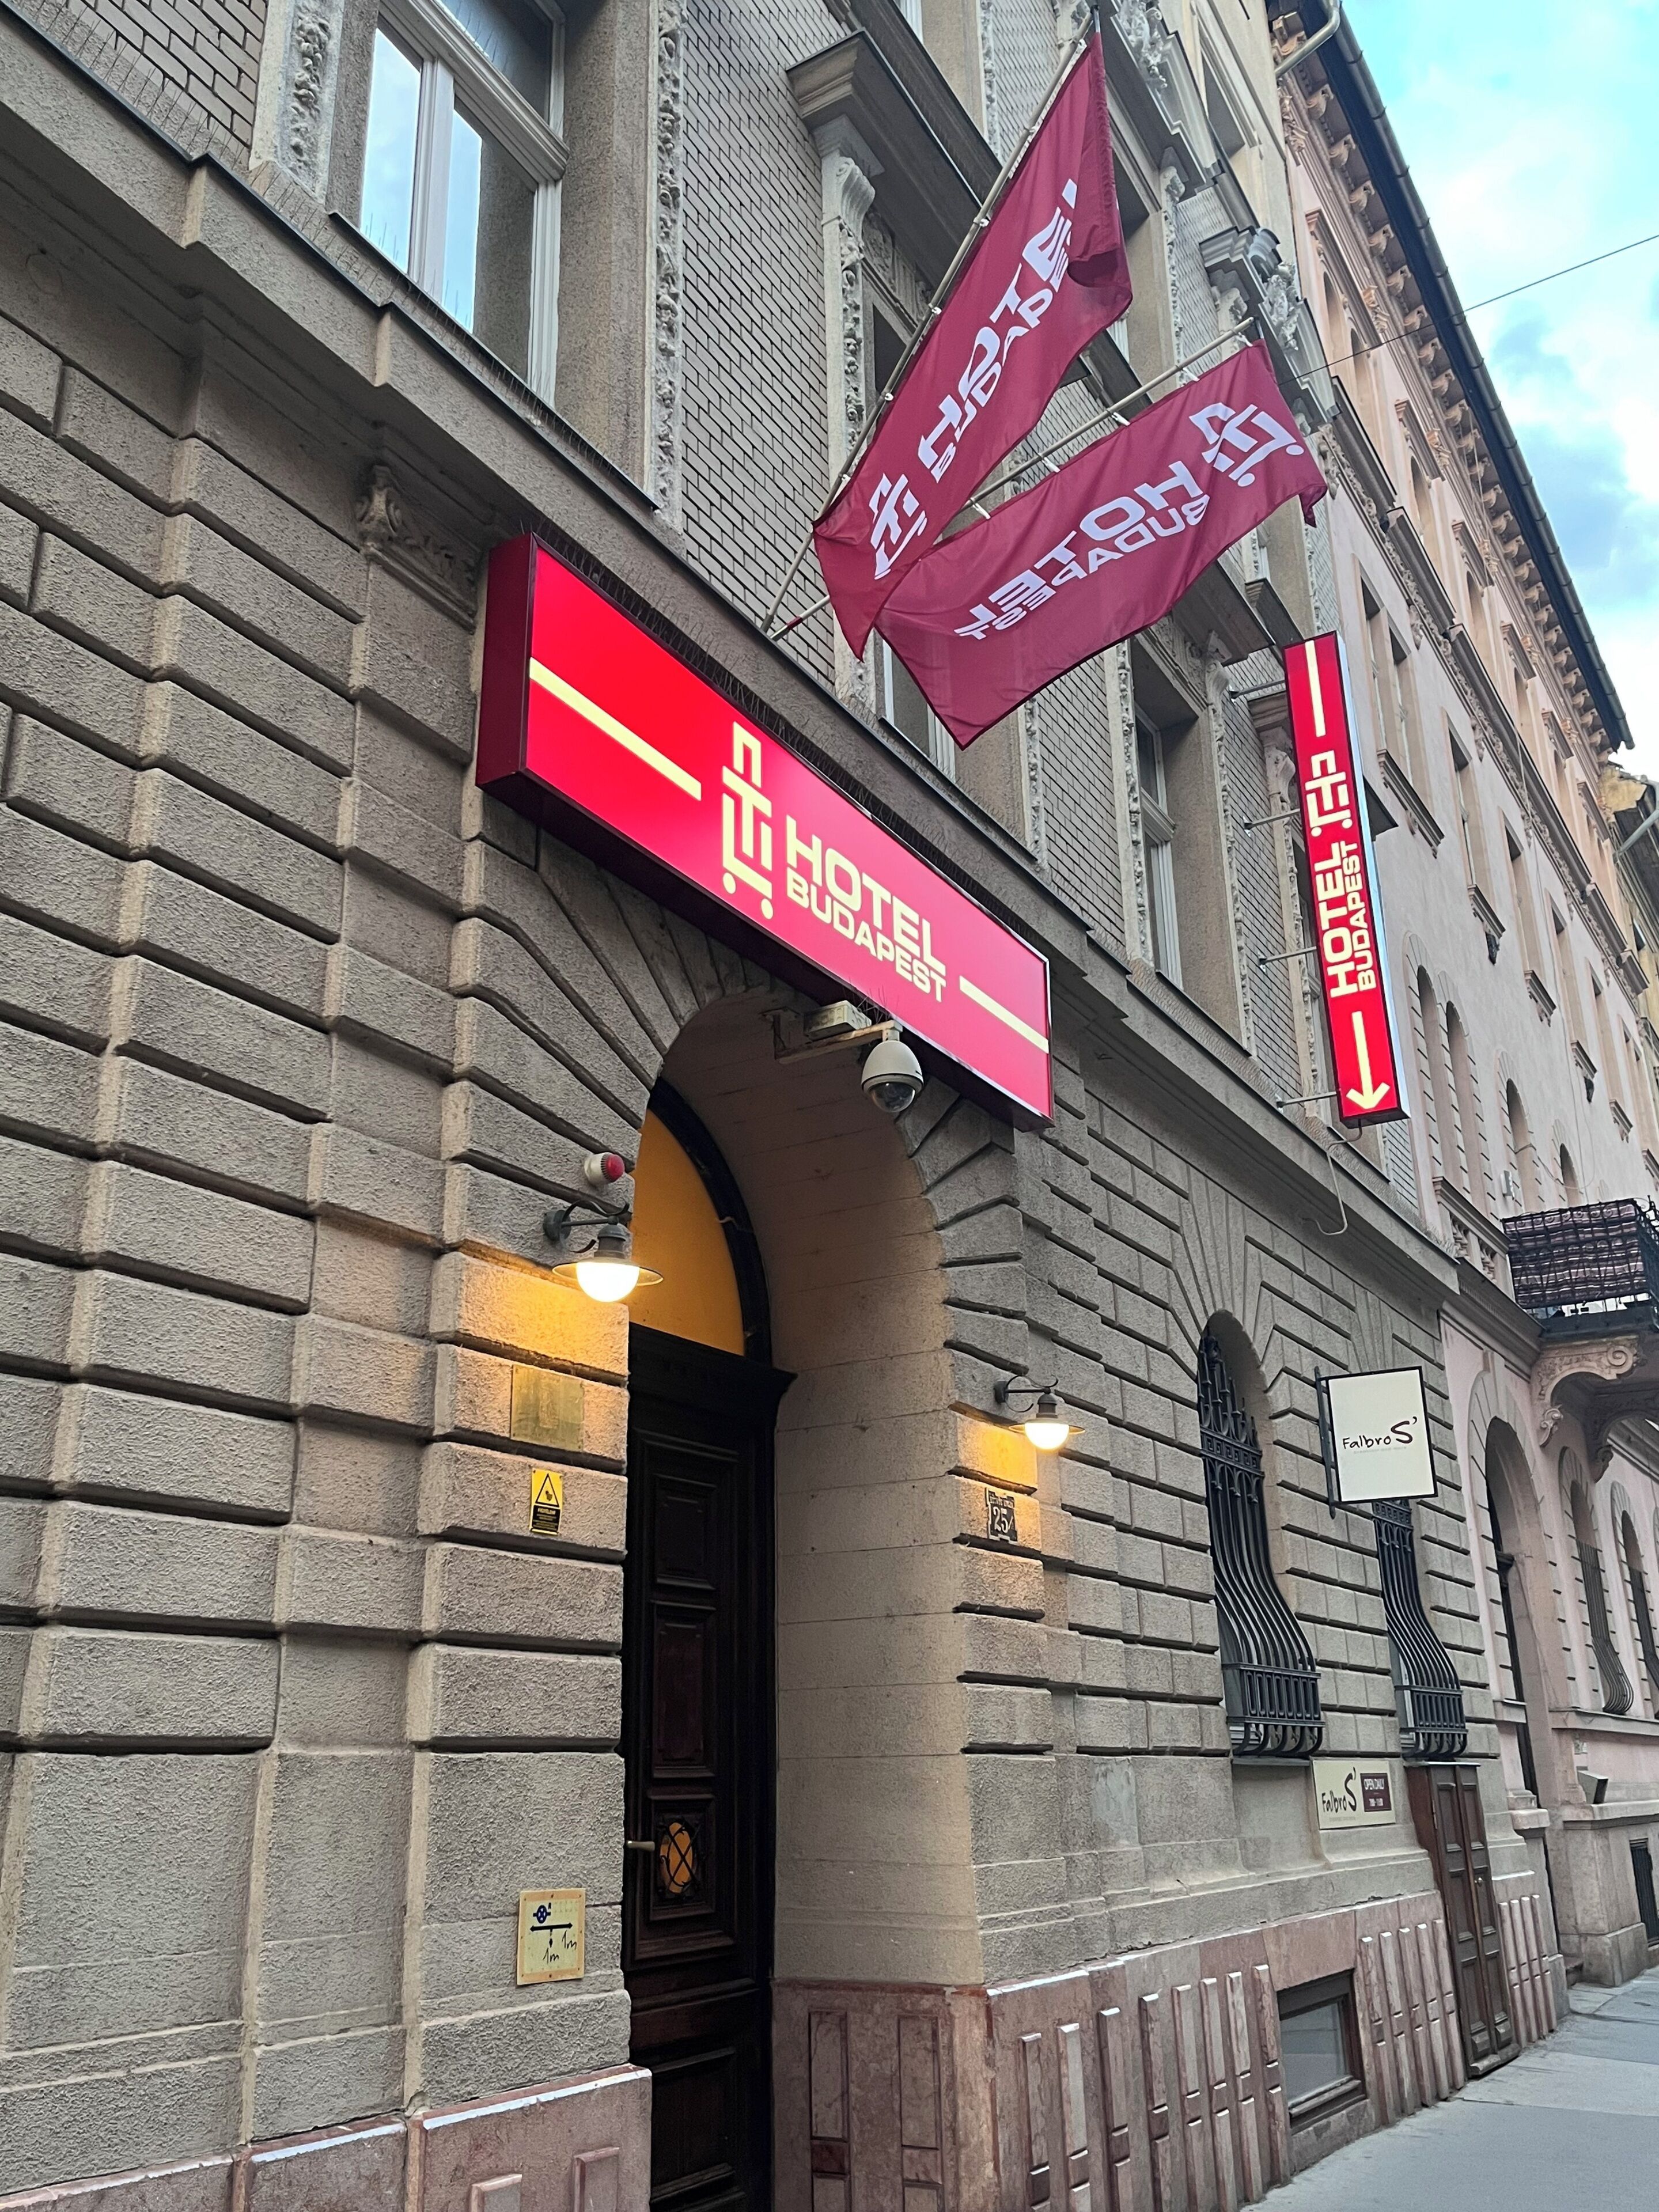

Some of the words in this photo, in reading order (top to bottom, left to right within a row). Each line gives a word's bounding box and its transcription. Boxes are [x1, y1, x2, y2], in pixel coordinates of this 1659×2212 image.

[931, 230, 1070, 483] BUDAPE
[786, 815, 946, 975] HOTEL
[786, 867, 946, 1002] BUDAPEST
[1313, 842, 1358, 998] HOTEL
[1341, 840, 1377, 992] BUDAPEST
